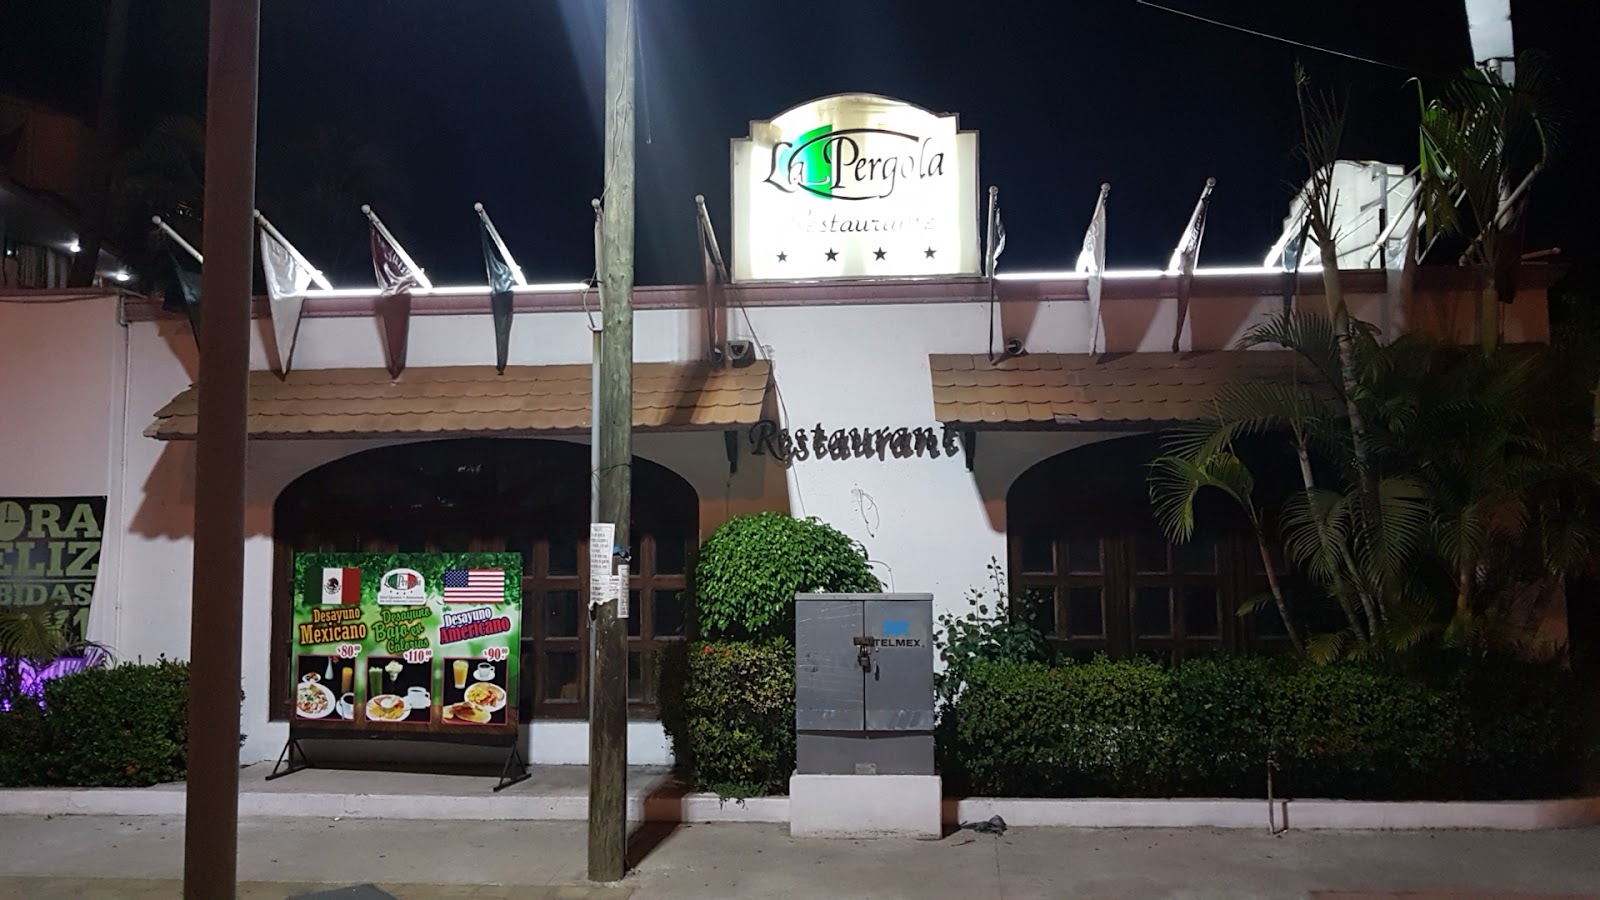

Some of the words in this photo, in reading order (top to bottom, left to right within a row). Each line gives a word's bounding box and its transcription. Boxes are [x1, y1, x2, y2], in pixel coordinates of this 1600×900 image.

[763, 141, 808, 193] La
[823, 136, 944, 198] Pergola
[750, 420, 959, 463] Restaurant
[313, 608, 360, 623] Desayuno
[381, 607, 431, 623] Desayuno
[444, 608, 492, 627] Desayuno
[300, 623, 366, 644] Mexicano
[372, 621, 408, 641] Bajo
[411, 623, 424, 636] en
[440, 617, 510, 643] Americano
